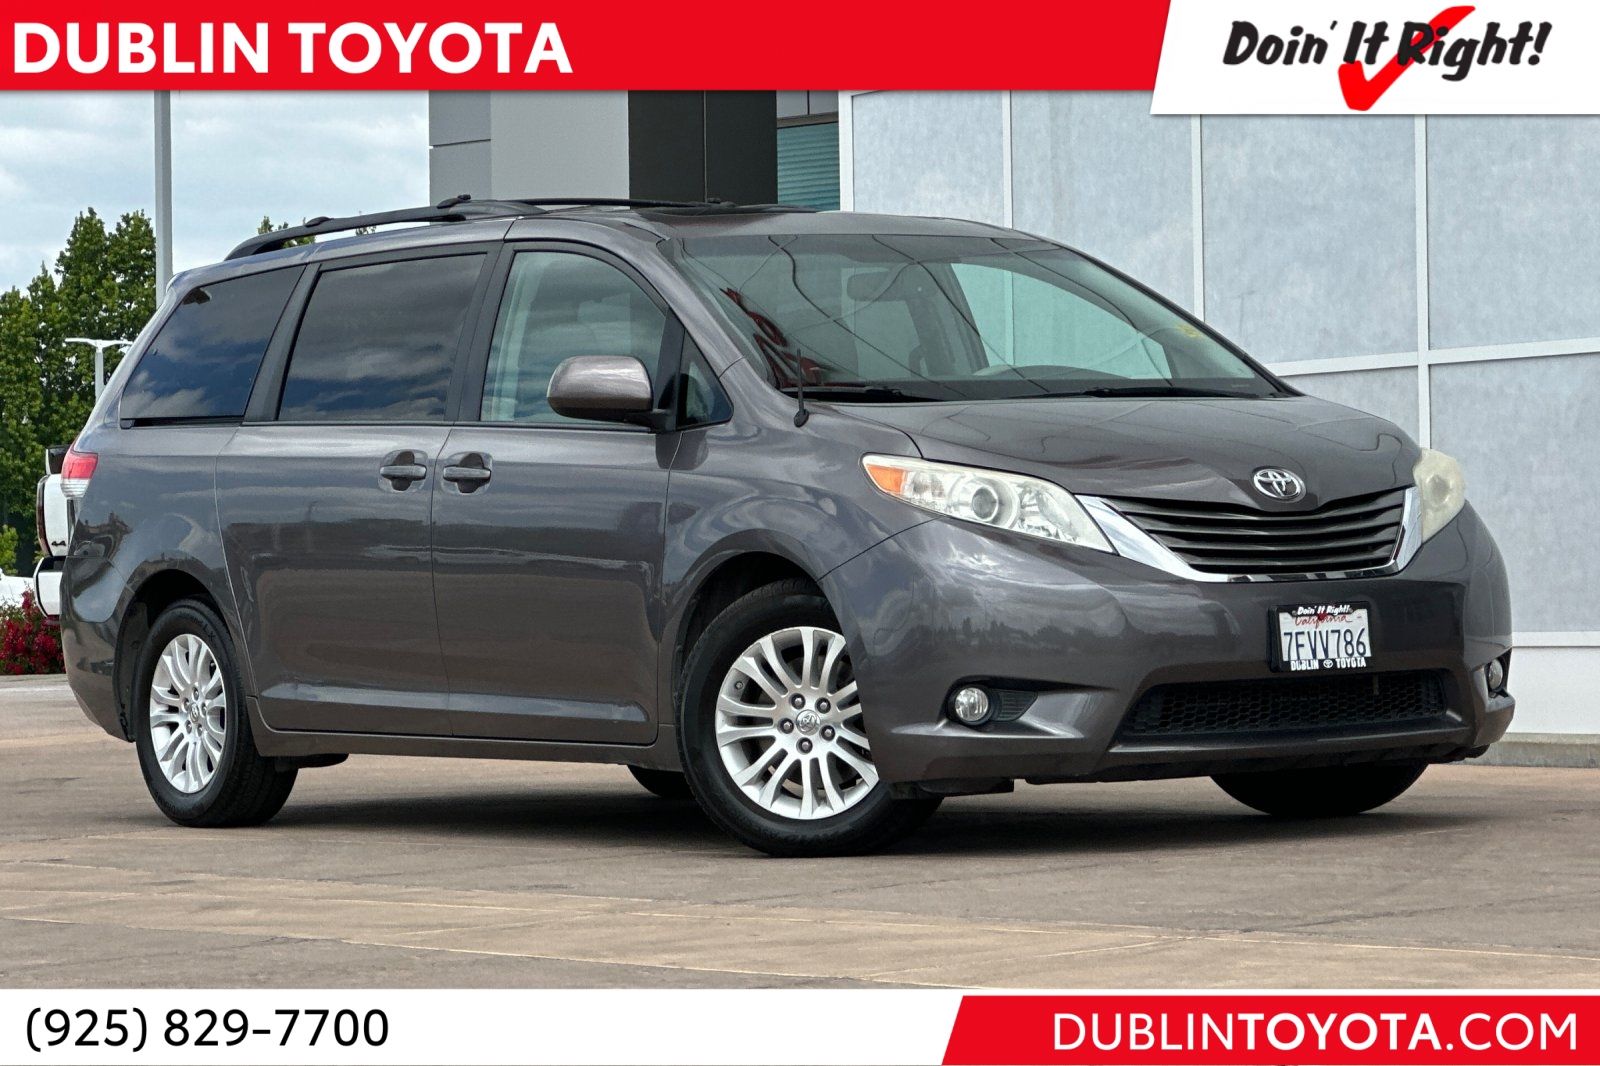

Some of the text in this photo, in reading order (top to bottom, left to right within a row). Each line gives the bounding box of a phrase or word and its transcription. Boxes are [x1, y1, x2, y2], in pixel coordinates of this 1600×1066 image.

[1326, 605, 1350, 615] Right!
[1290, 657, 1366, 671] DUBLIN TOYOTA
